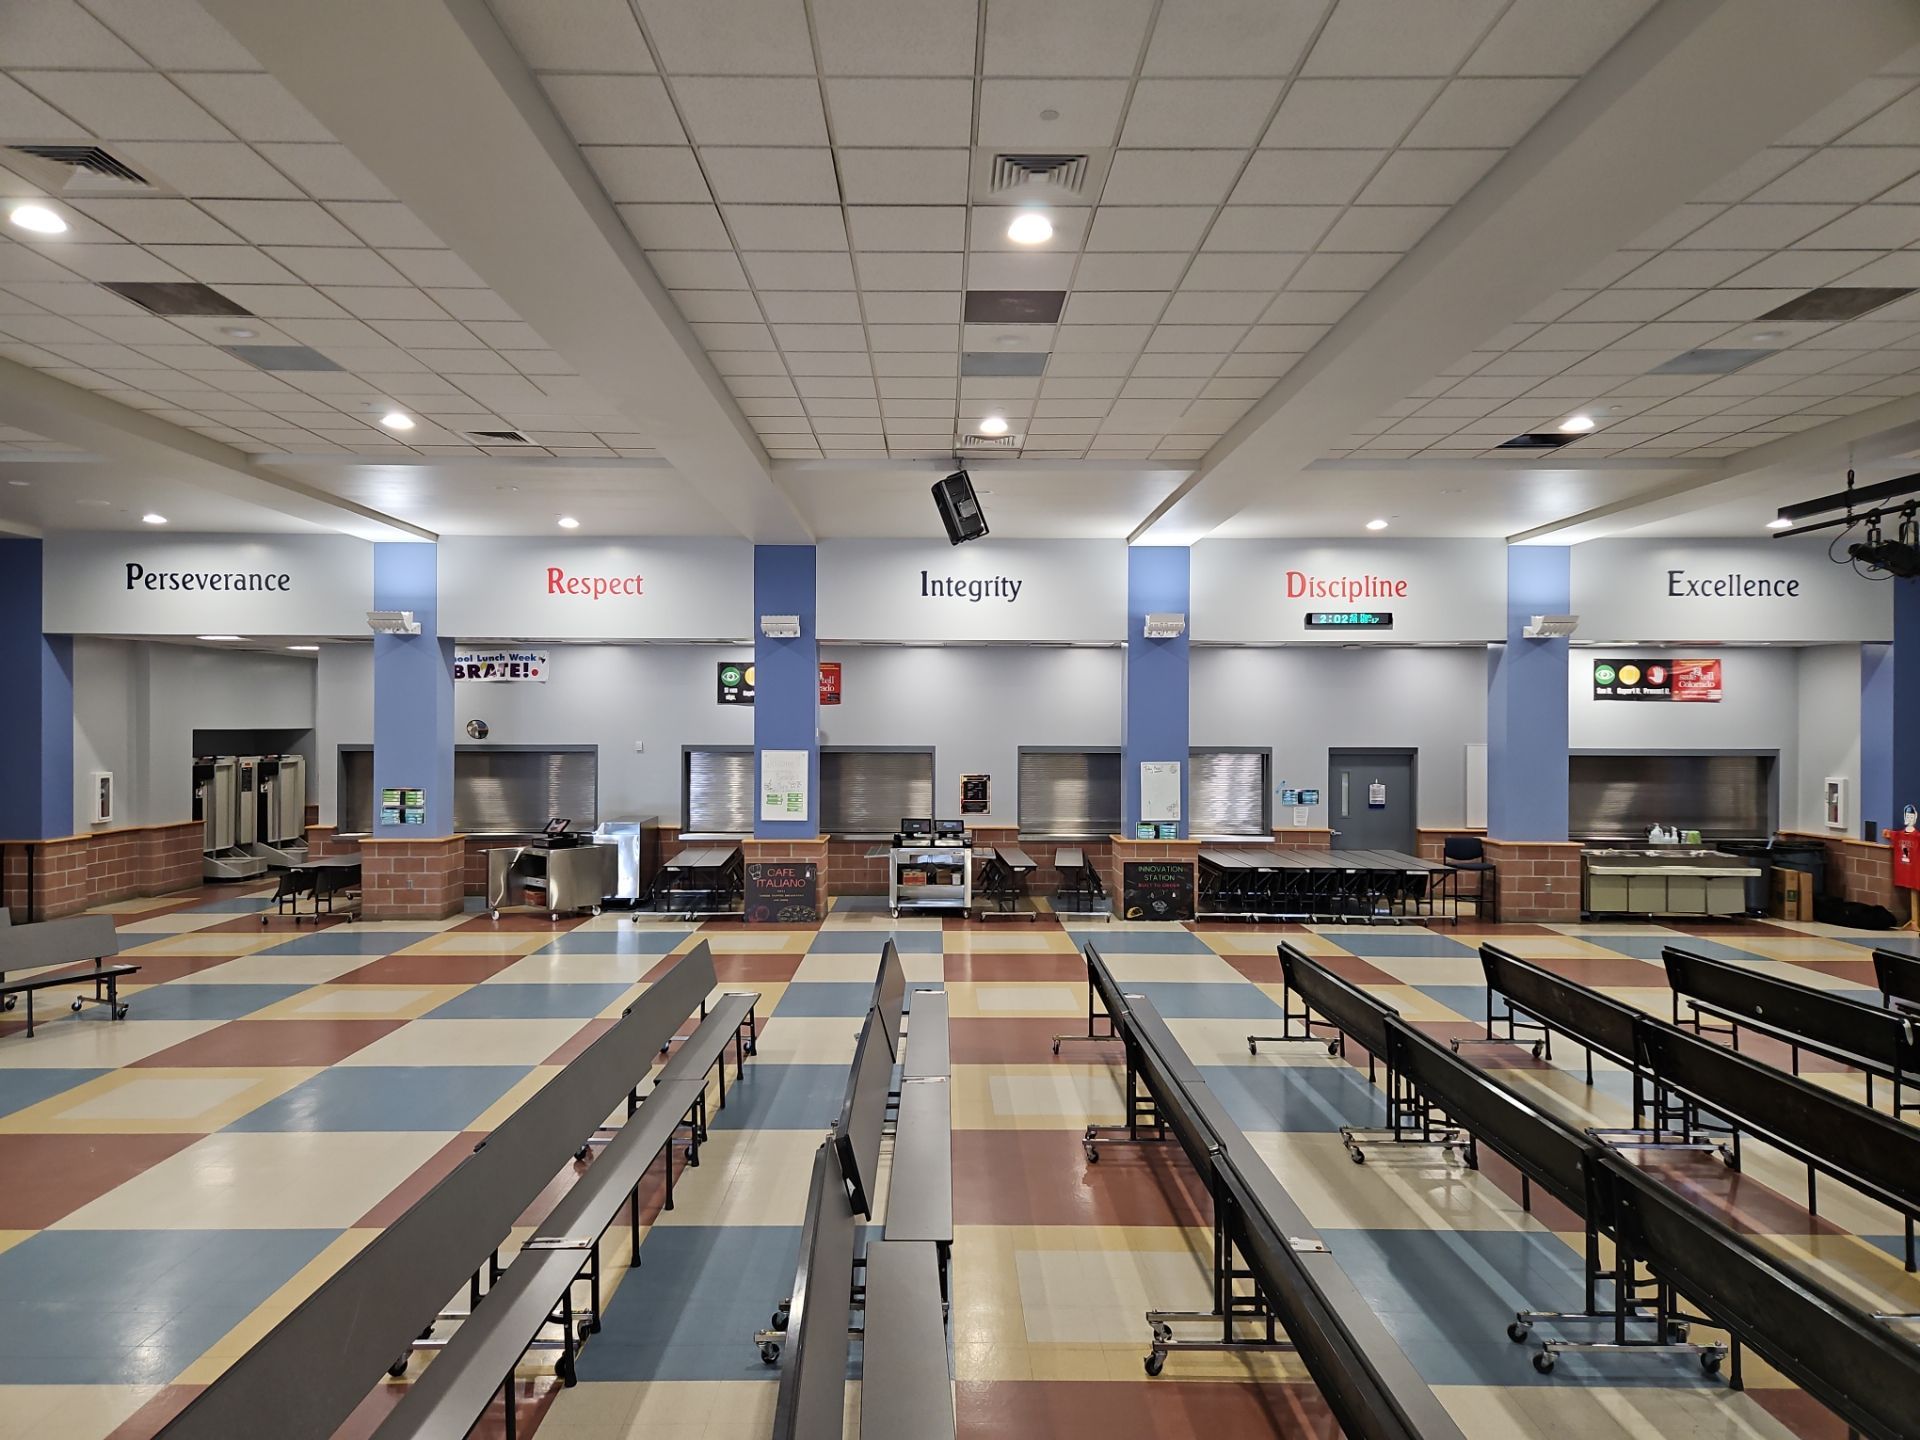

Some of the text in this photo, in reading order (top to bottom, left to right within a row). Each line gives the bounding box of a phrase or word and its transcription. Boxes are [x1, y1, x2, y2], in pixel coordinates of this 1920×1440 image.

[126, 563, 291, 591] Perseverance
[546, 567, 644, 600] Respect
[921, 570, 1023, 602] Integrity
[1667, 570, 1800, 597] Excellence
[1286, 571, 1408, 602] Discipline
[1319, 614, 1348, 624] 2:02
[477, 653, 505, 662] Lunch
[509, 653, 537, 662] Week
[767, 868, 796, 877] CAFE
[1138, 865, 1184, 873] INNOVATION
[756, 879, 806, 888] ITALIANO
